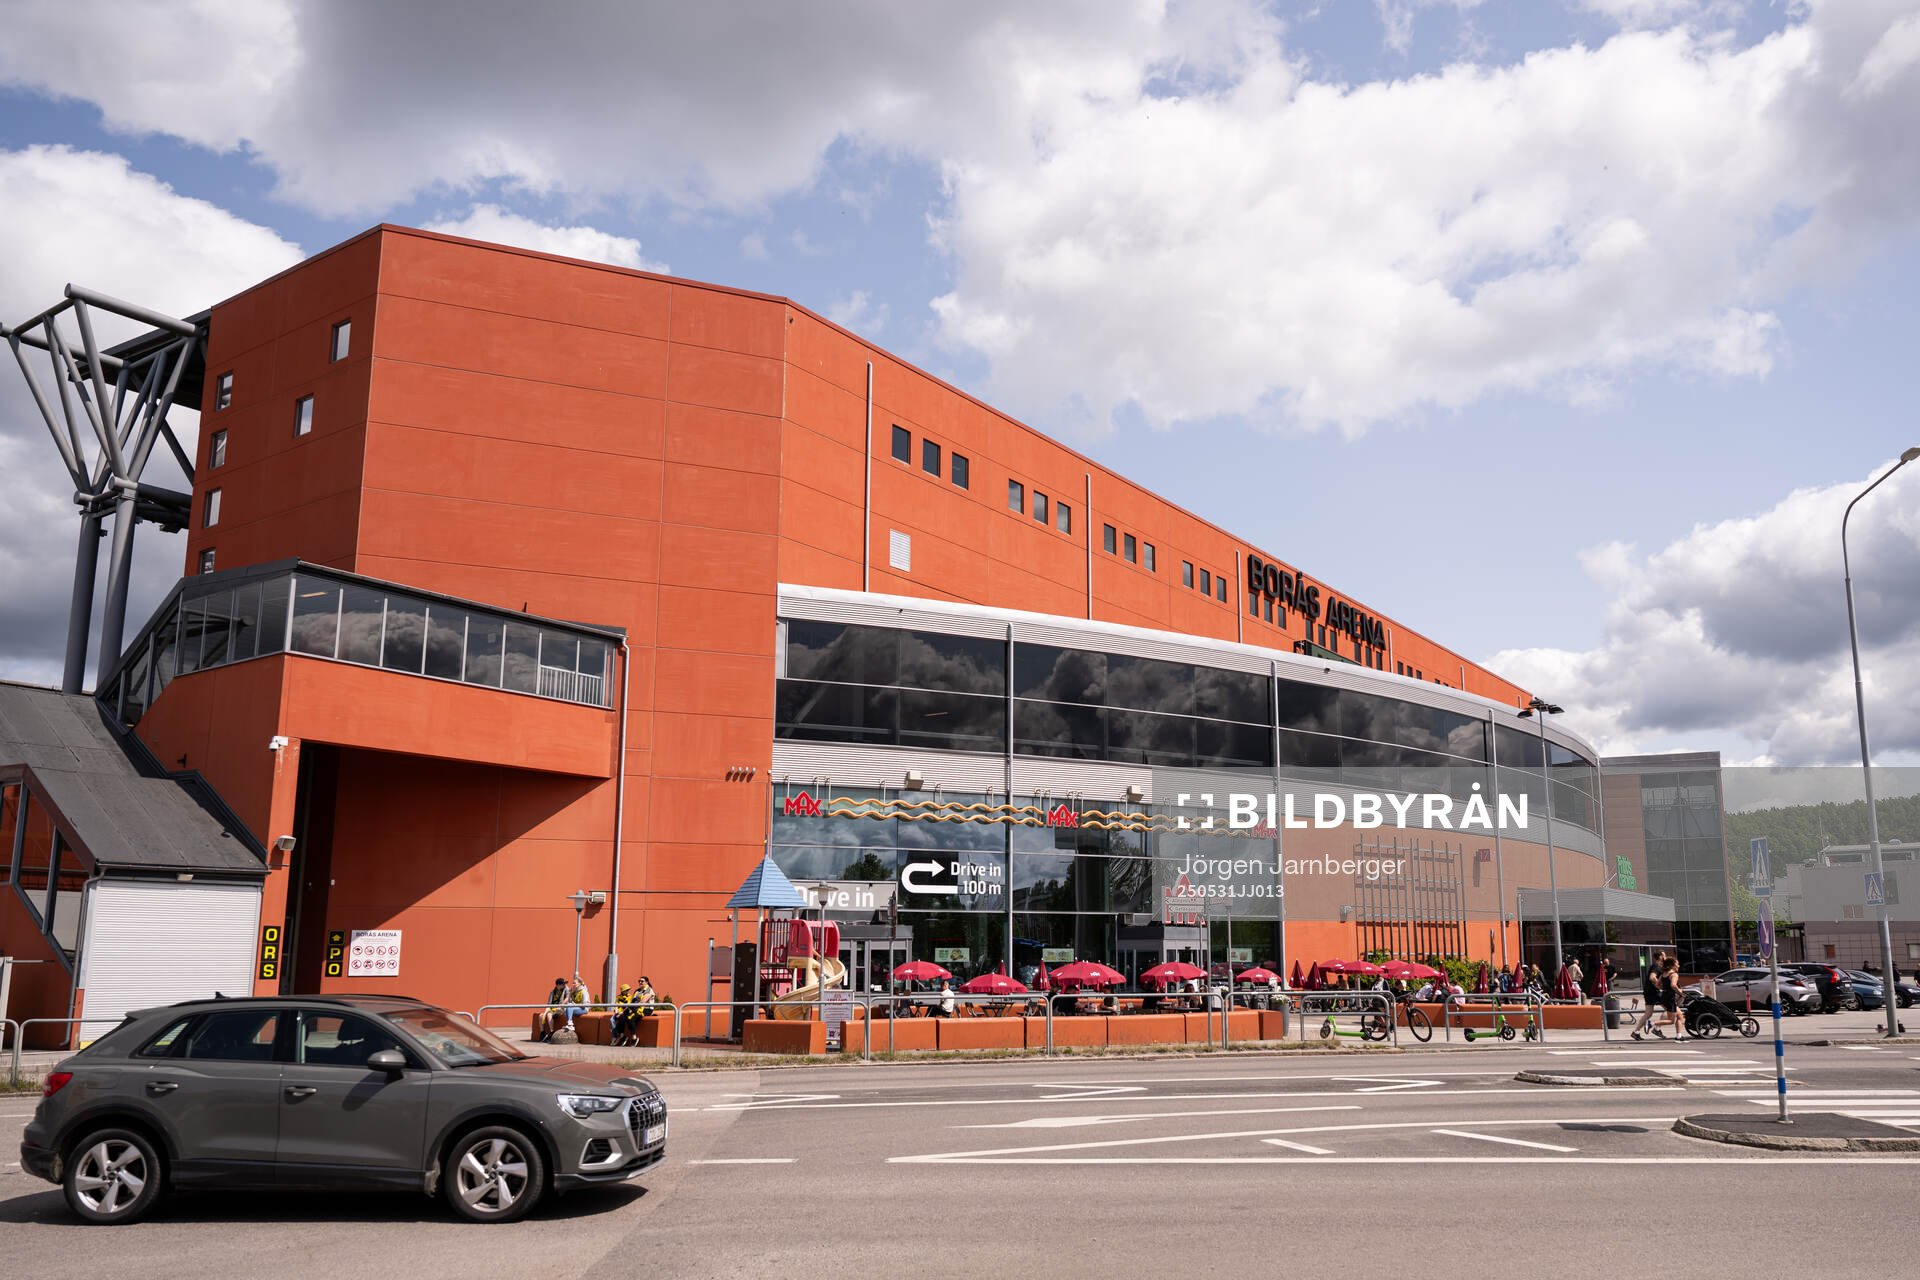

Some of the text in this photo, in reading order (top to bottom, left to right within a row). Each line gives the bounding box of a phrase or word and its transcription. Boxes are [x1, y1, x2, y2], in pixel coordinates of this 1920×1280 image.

[1248, 554, 1387, 651] BORÅS ARENA
[784, 790, 822, 816] MAX
[1047, 804, 1079, 828] MAX
[951, 862, 1001, 877] Drive in
[794, 886, 874, 908] Drve in
[963, 881, 1001, 895] 100 m
